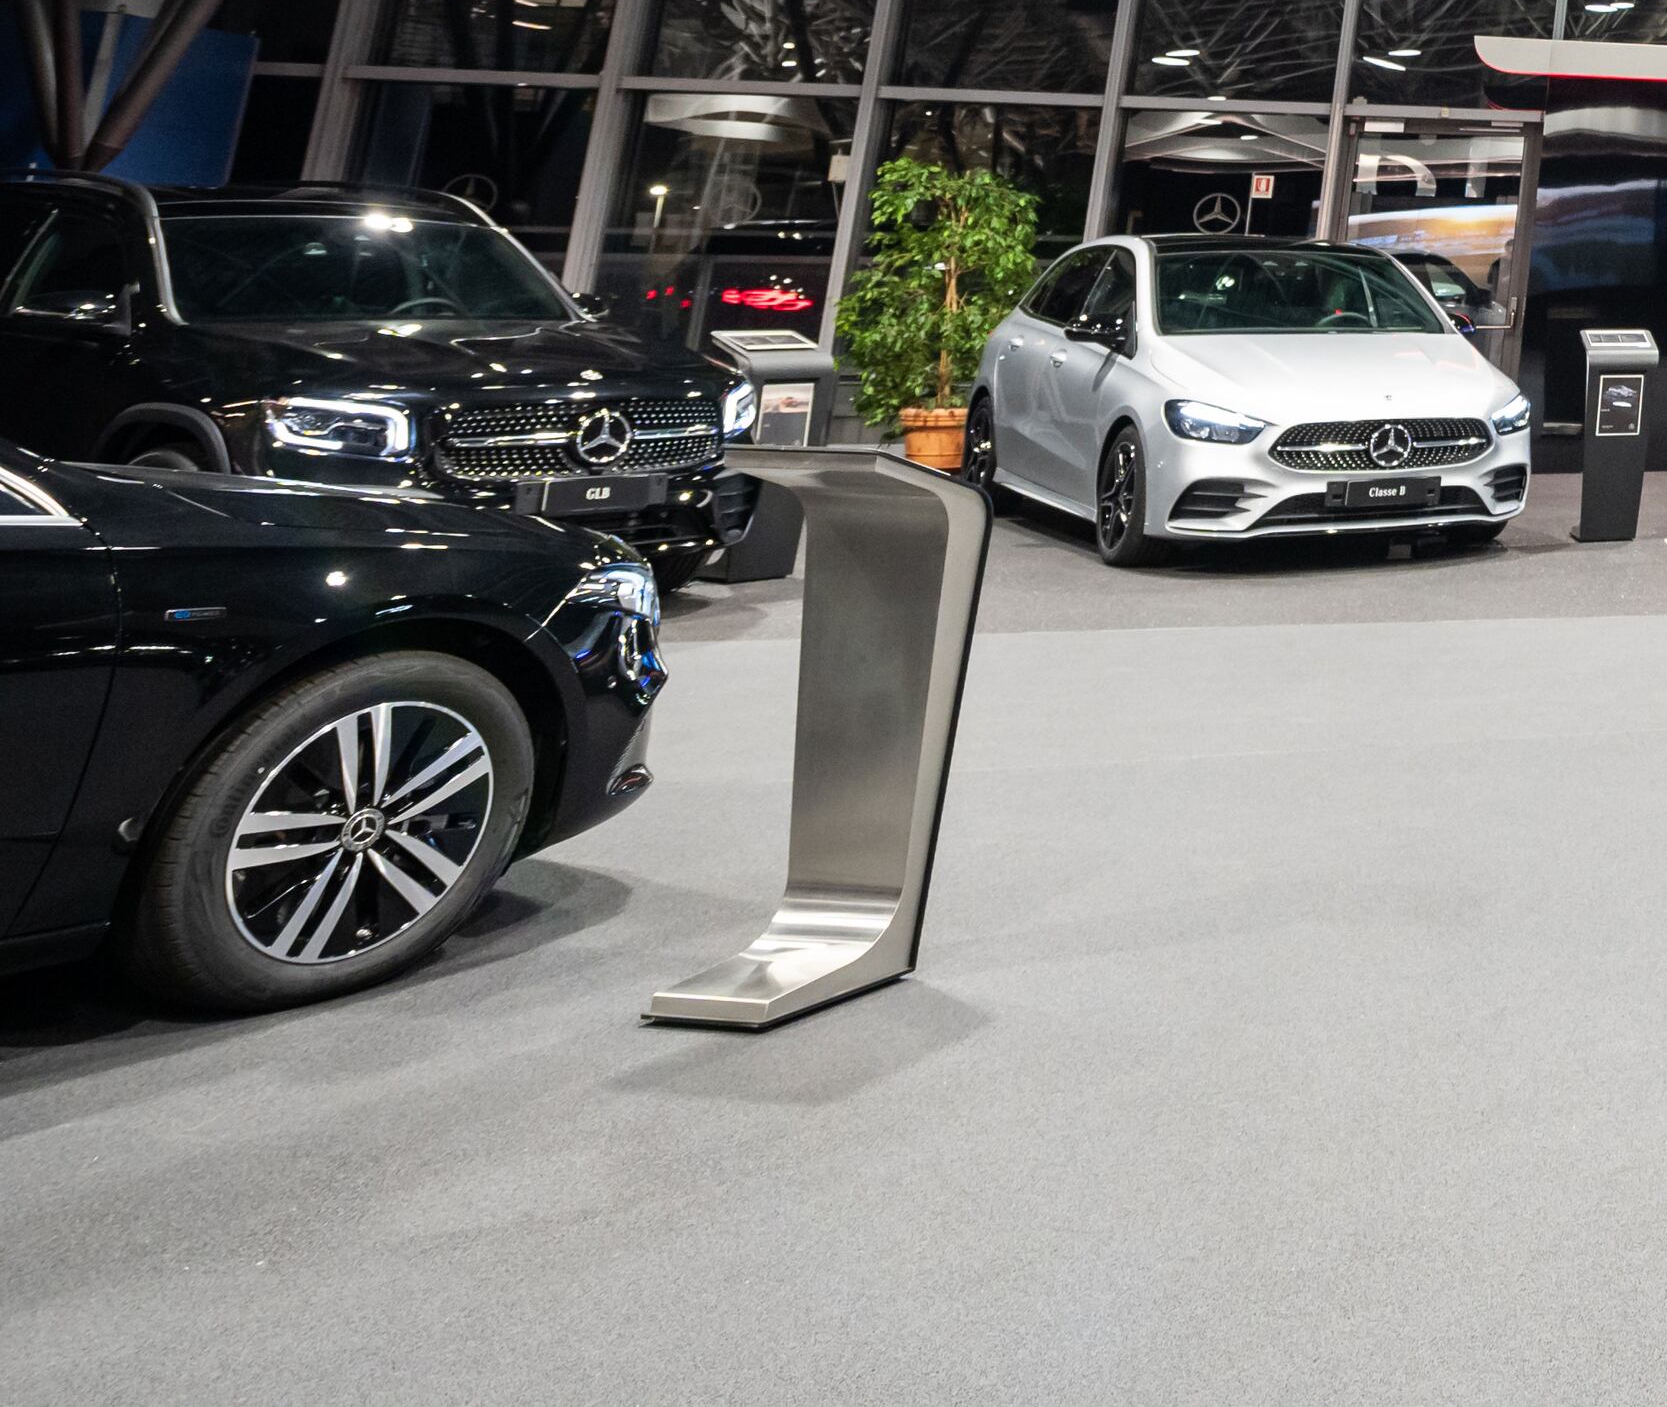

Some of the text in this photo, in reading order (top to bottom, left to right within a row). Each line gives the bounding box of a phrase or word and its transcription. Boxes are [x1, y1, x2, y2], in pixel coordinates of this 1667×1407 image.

[585, 487, 611, 500] GLB
[1369, 485, 1406, 498] Classe B
